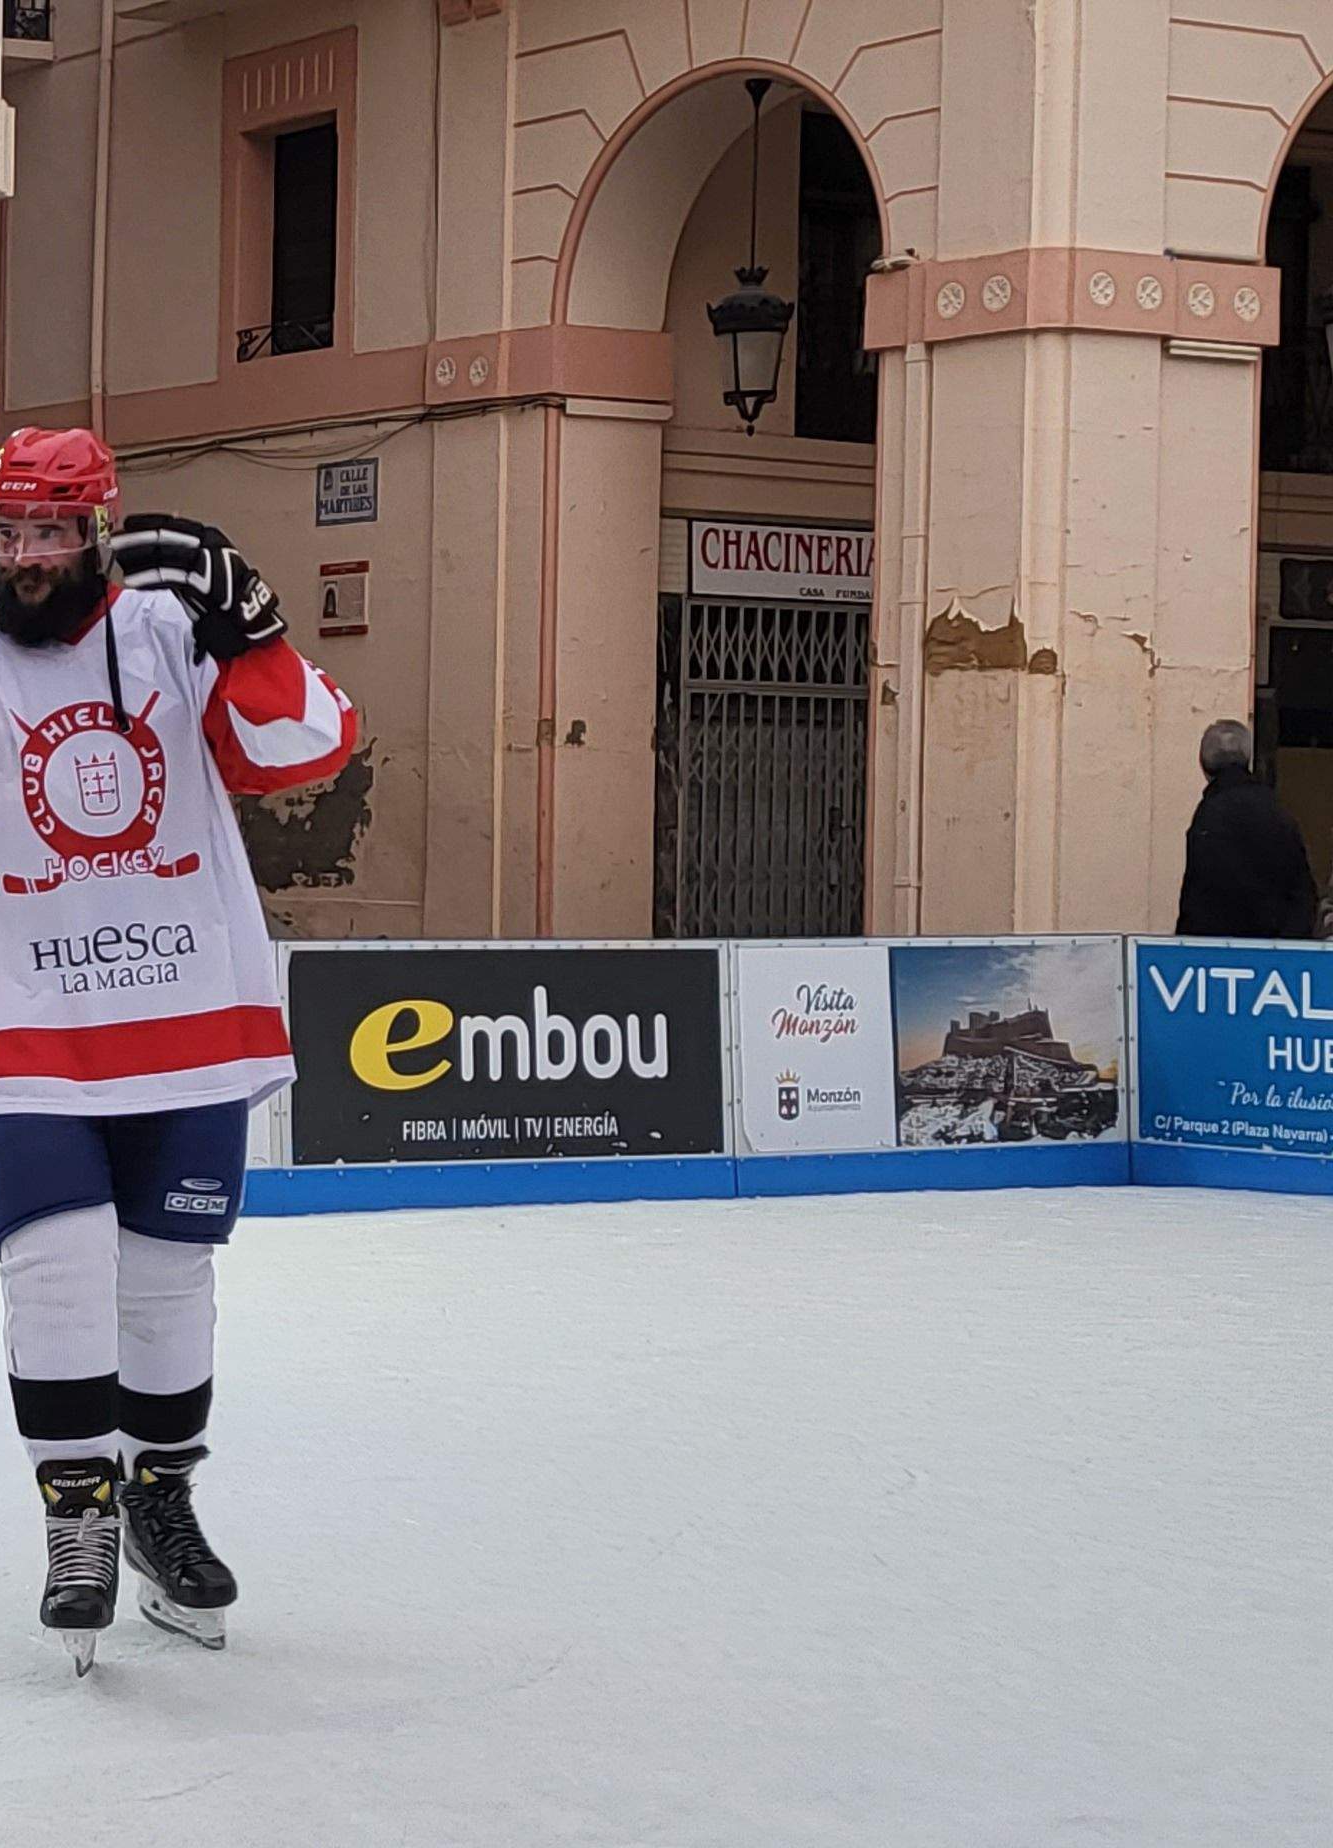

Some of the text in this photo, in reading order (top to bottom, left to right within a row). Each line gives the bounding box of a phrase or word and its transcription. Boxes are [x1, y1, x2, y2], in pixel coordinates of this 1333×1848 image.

[1, 481, 37, 491] CCM
[340, 467, 369, 483] CALLE
[352, 482, 368, 494] LAS
[799, 587, 874, 600] CASA FUNDA
[23, 753, 56, 836] CLUB
[139, 746, 164, 826] JACA
[44, 846, 165, 884] HOCKEY
[796, 984, 857, 1015] Visita
[771, 1008, 860, 1043] Monzón
[348, 985, 670, 1091] embou
[806, 1086, 861, 1104] Monzón
[1265, 1084, 1283, 1108] la
[402, 1110, 619, 1142] FIBRA MÓVIL TV ENERGÍA
[1154, 1115, 1172, 1131] C/
[1174, 1117, 1219, 1136] Parque
[1221, 1121, 1230, 1134] 2
[1232, 1121, 1270, 1138] (Plaza
[165, 1192, 230, 1215] CCM
[51, 1474, 102, 1489] BAUER
